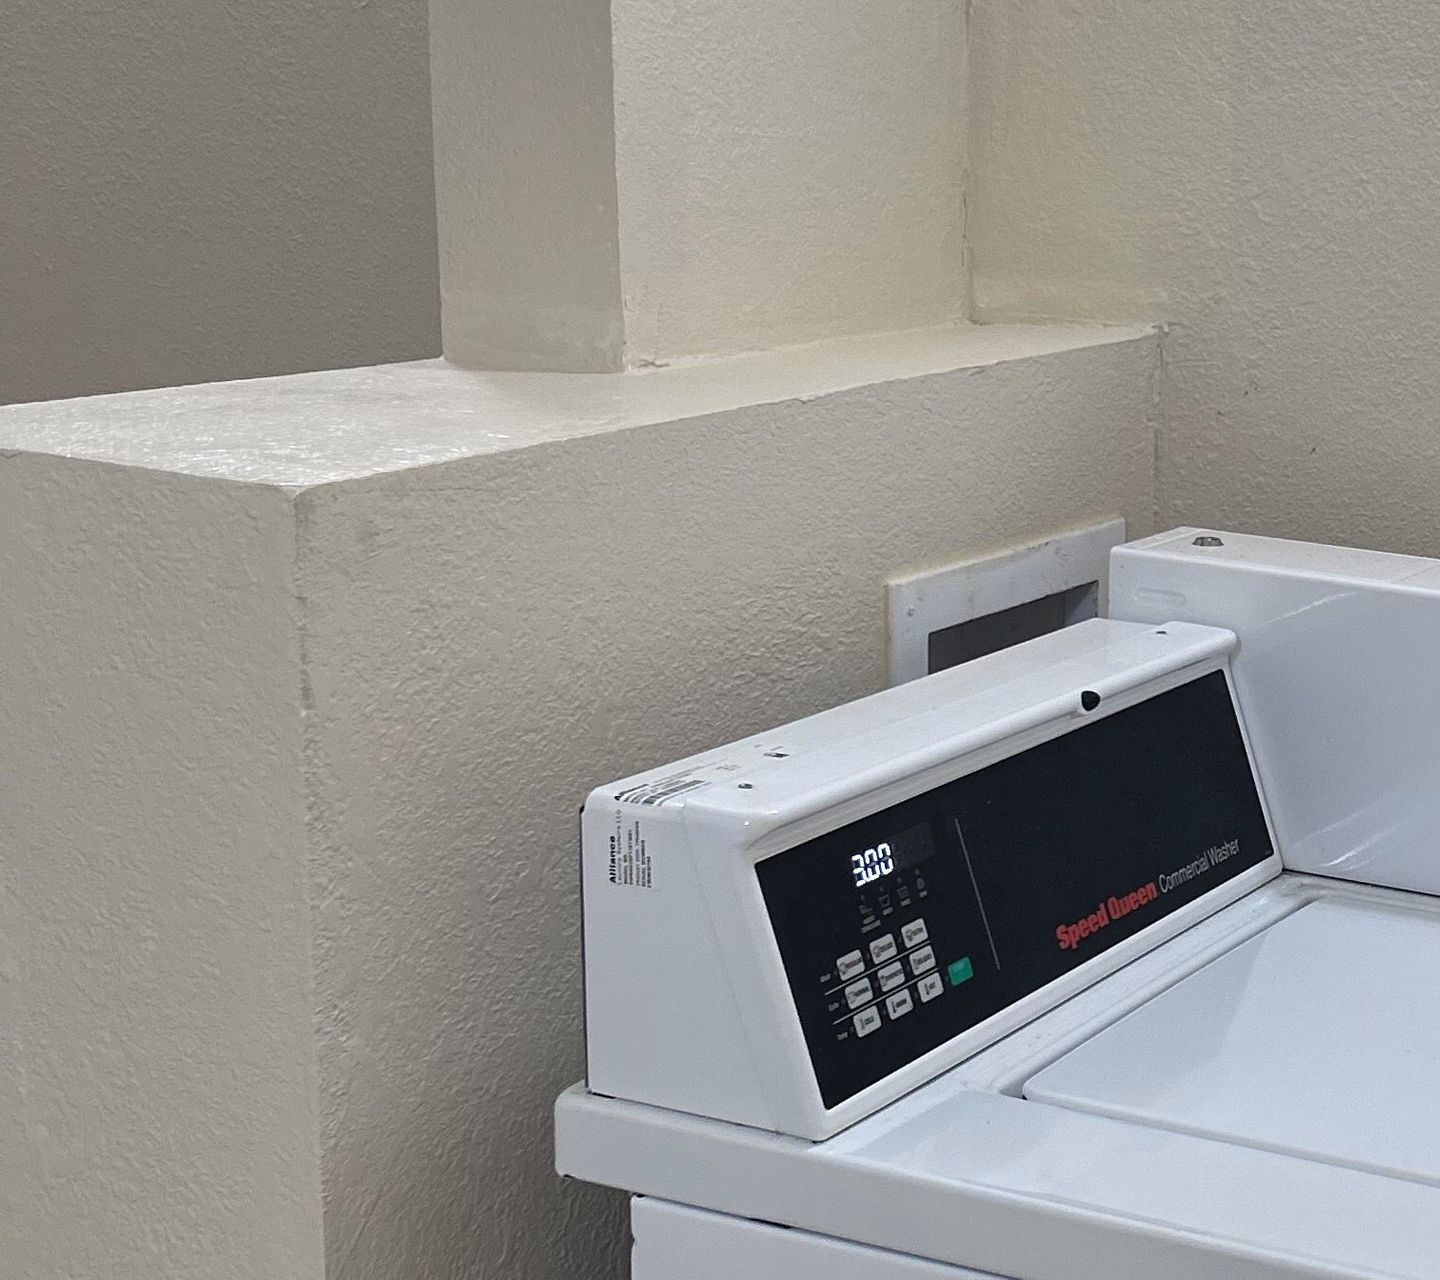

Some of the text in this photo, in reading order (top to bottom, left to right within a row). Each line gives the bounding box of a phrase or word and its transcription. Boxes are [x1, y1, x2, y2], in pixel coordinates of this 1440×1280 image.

[1055, 838, 1240, 950] Speed Queen Commercial Washer
